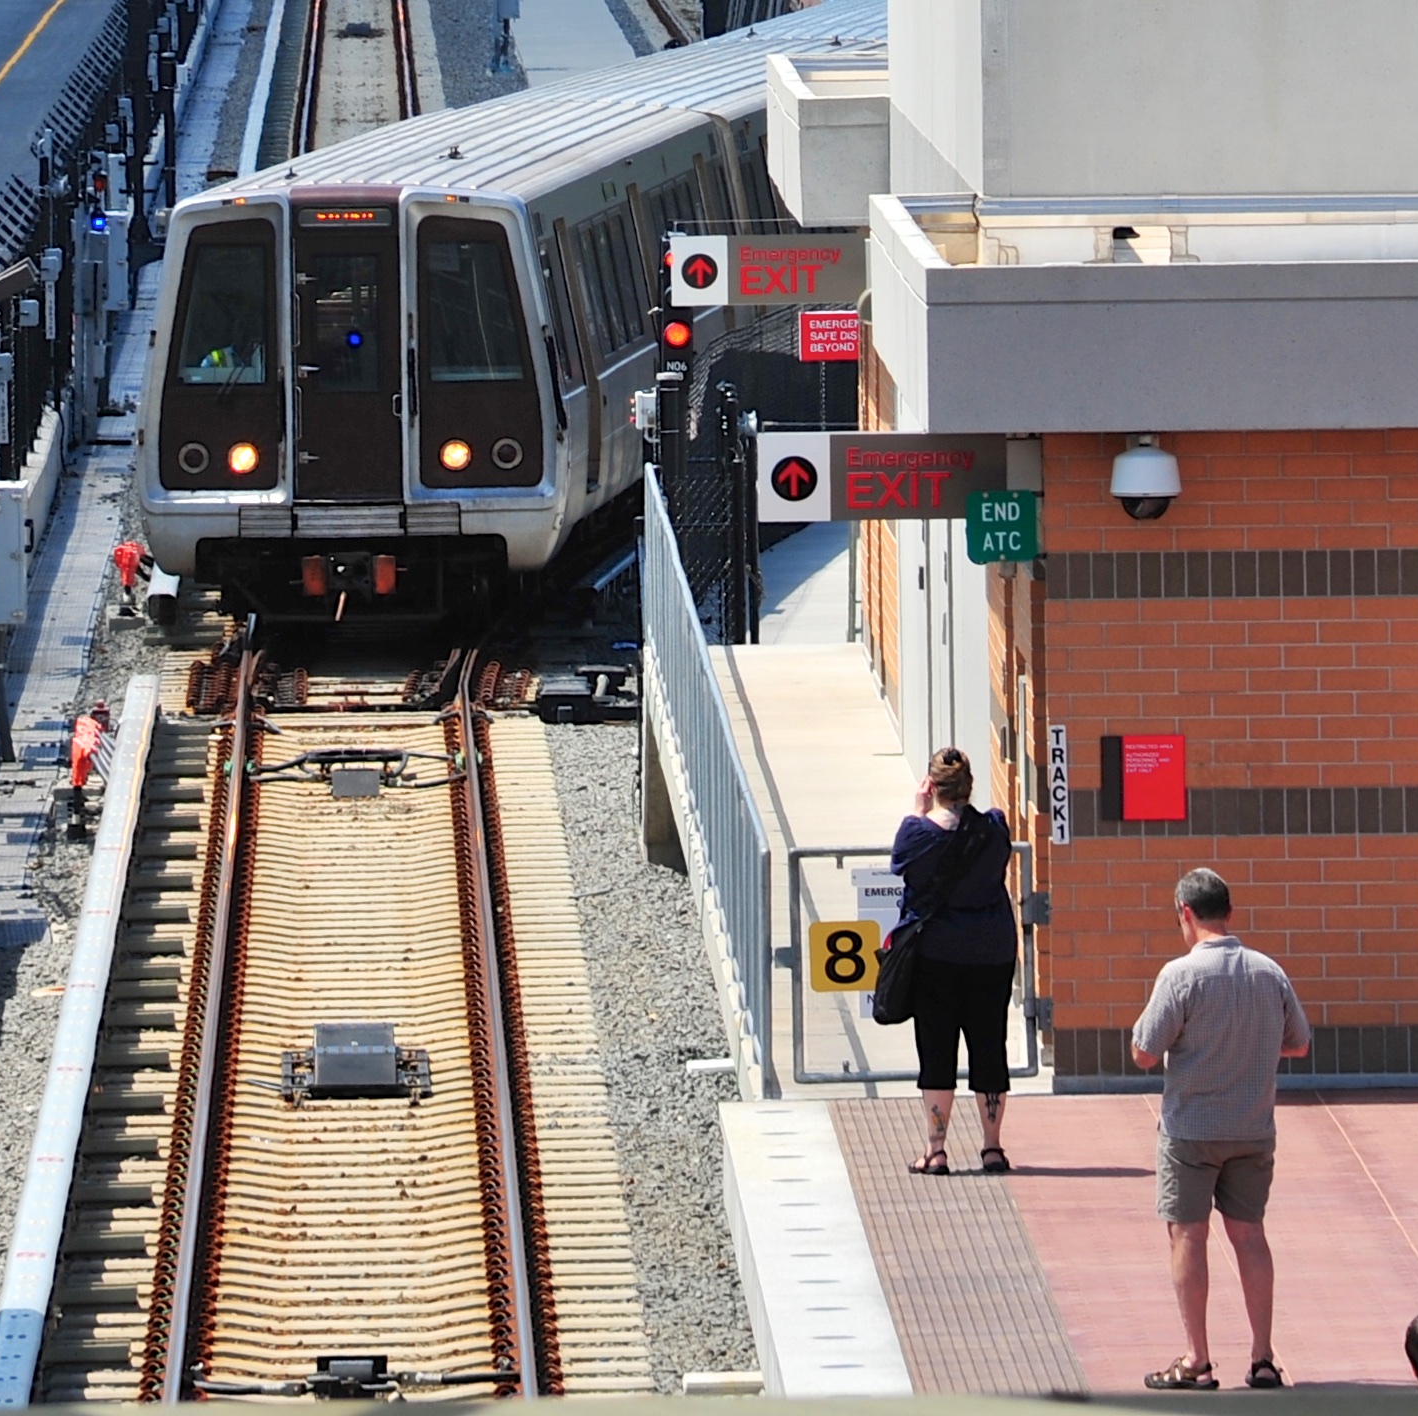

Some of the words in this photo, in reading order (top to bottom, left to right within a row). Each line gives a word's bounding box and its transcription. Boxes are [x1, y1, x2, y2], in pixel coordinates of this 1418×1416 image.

[740, 246, 841, 264] Emergency
[740, 264, 823, 295] EXIT
[809, 320, 859, 329] EMERGEN
[810, 331, 837, 340] SAFE
[810, 343, 855, 352] BEYOND
[846, 447, 976, 471] Emergency
[847, 471, 951, 509] EXIT
[981, 502, 1021, 522] END
[983, 532, 1021, 551] ATC
[1051, 728, 1066, 821] TRACK
[865, 887, 903, 897] EMERG
[825, 930, 866, 984] 8
